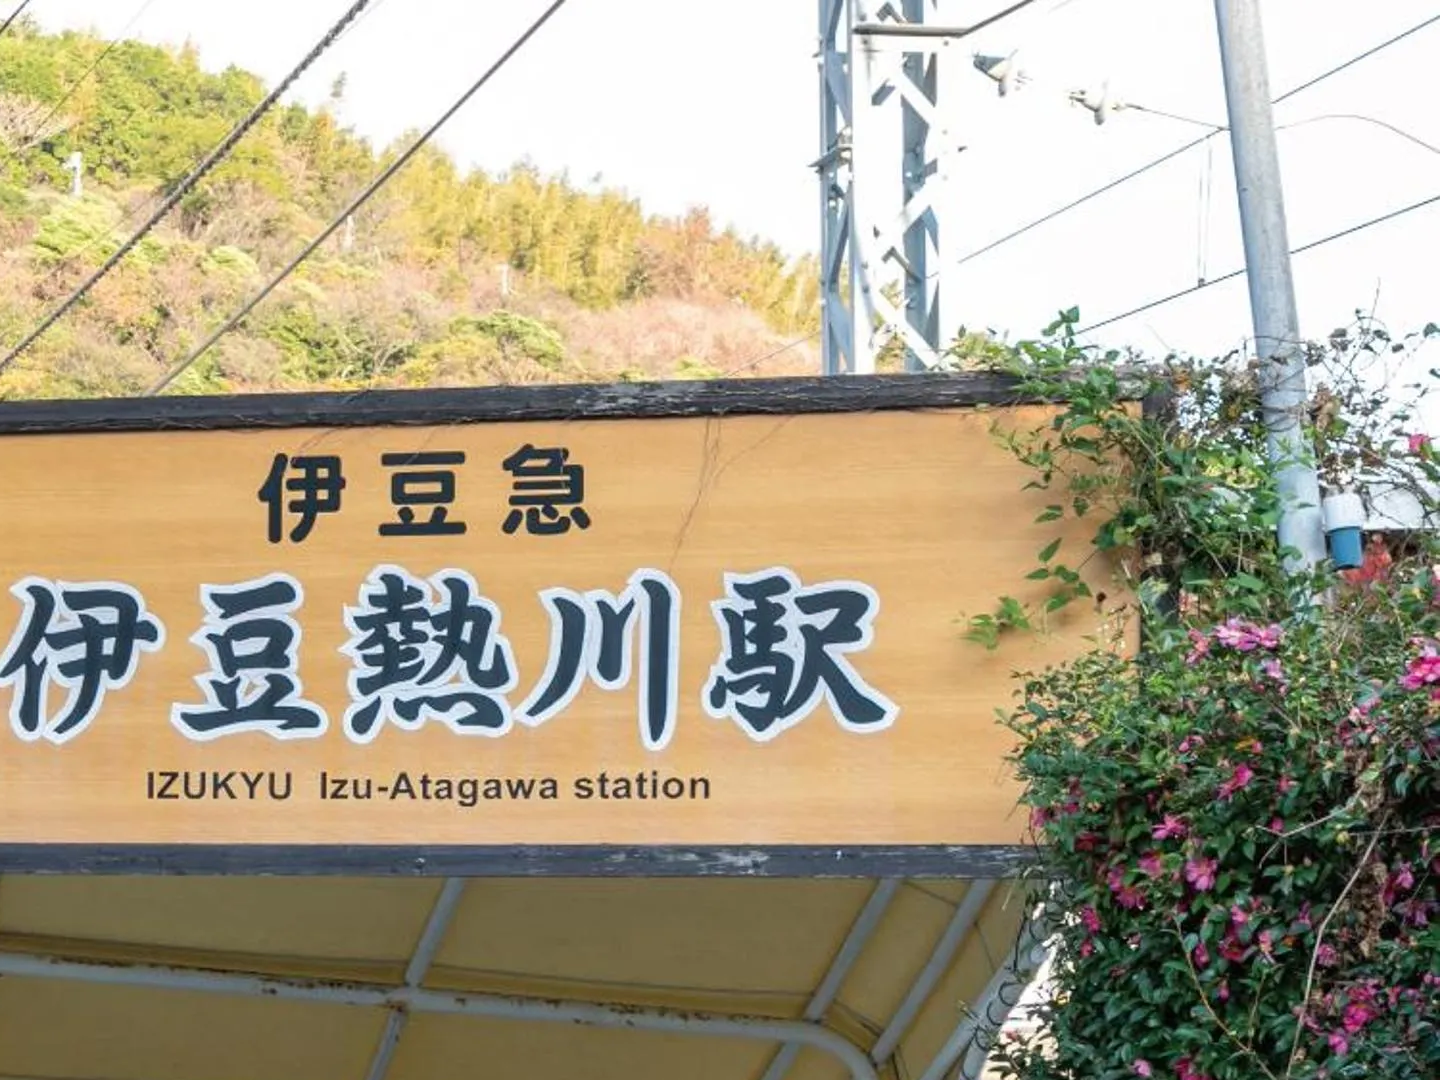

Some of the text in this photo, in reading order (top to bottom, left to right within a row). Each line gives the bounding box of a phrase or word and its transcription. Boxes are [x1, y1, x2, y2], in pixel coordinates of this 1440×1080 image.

[257, 442, 592, 544] 伊豆急
[147, 770, 711, 808] IZUKYU Izu-Atagawa station
